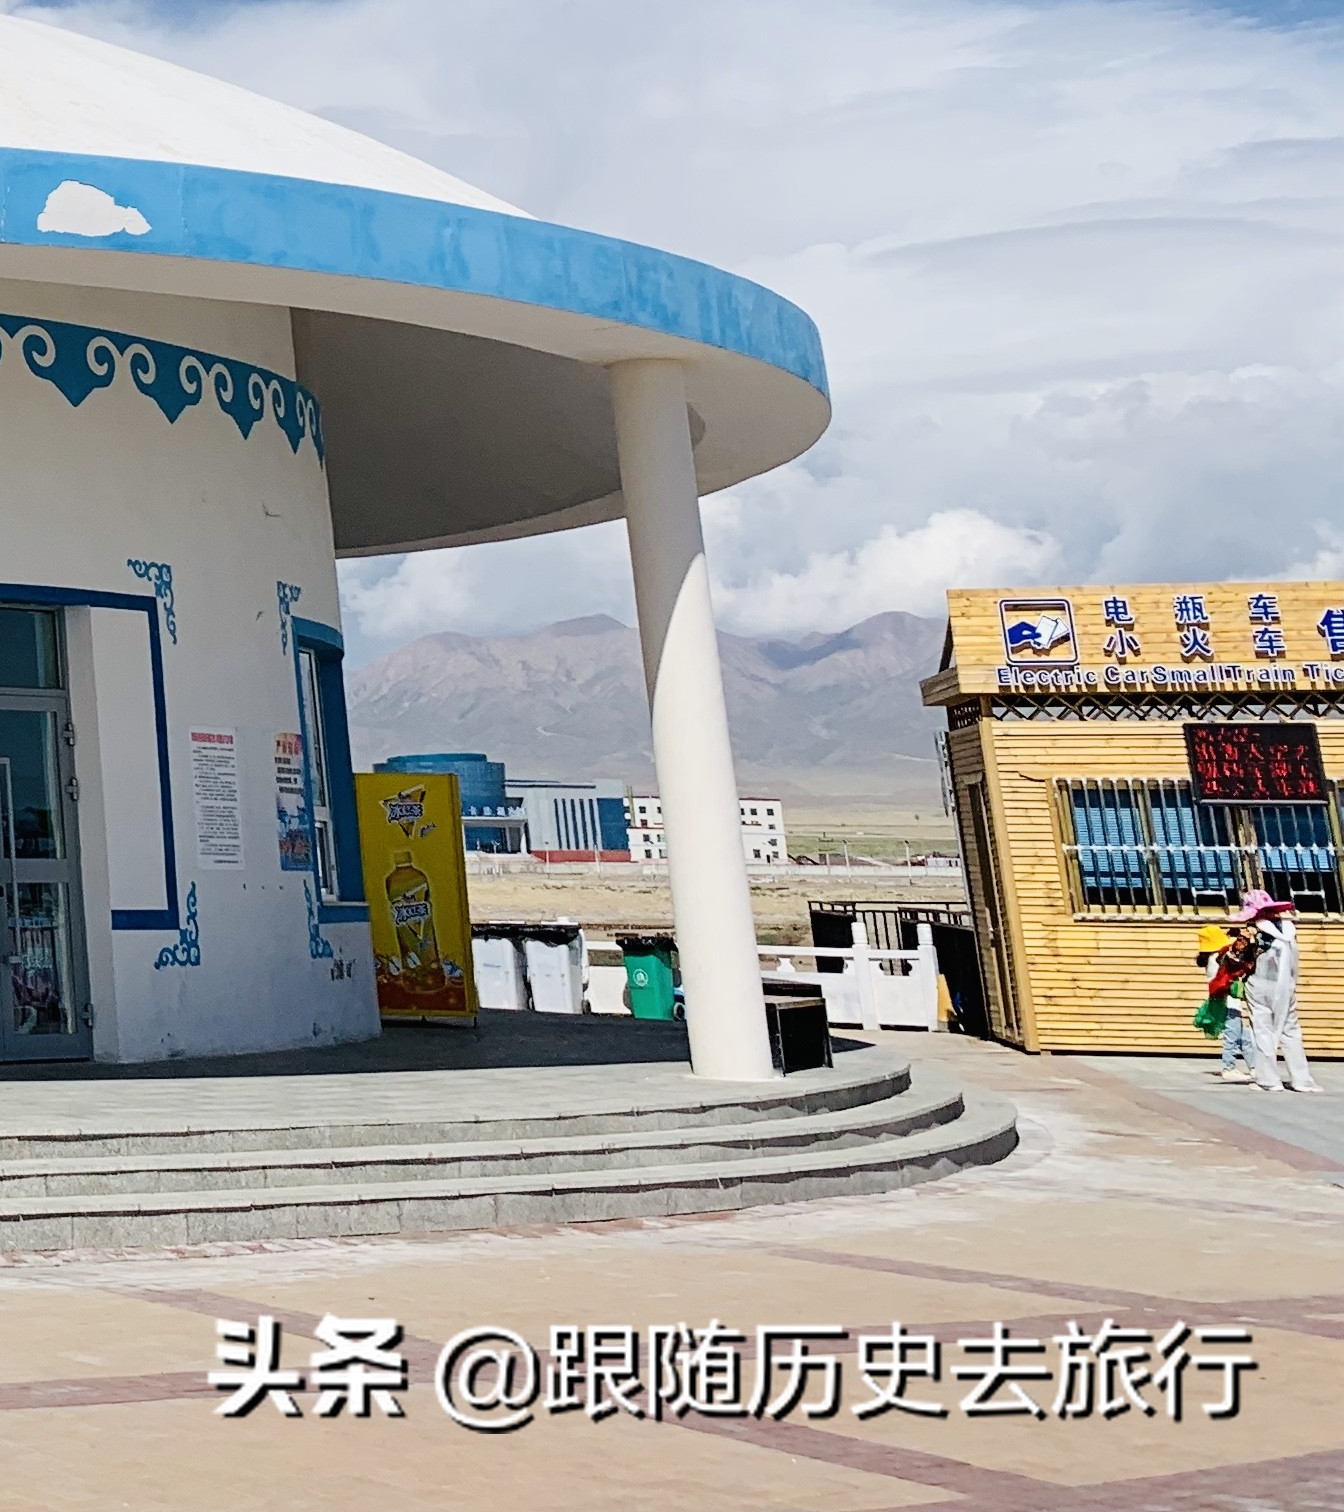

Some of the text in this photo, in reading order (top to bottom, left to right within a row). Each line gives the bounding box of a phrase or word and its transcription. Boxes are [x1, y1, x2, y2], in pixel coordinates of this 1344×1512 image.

[1103, 594, 1281, 624] 电瓶车
[1105, 626, 1285, 657] 小火车
[996, 666, 1098, 685] Electric
